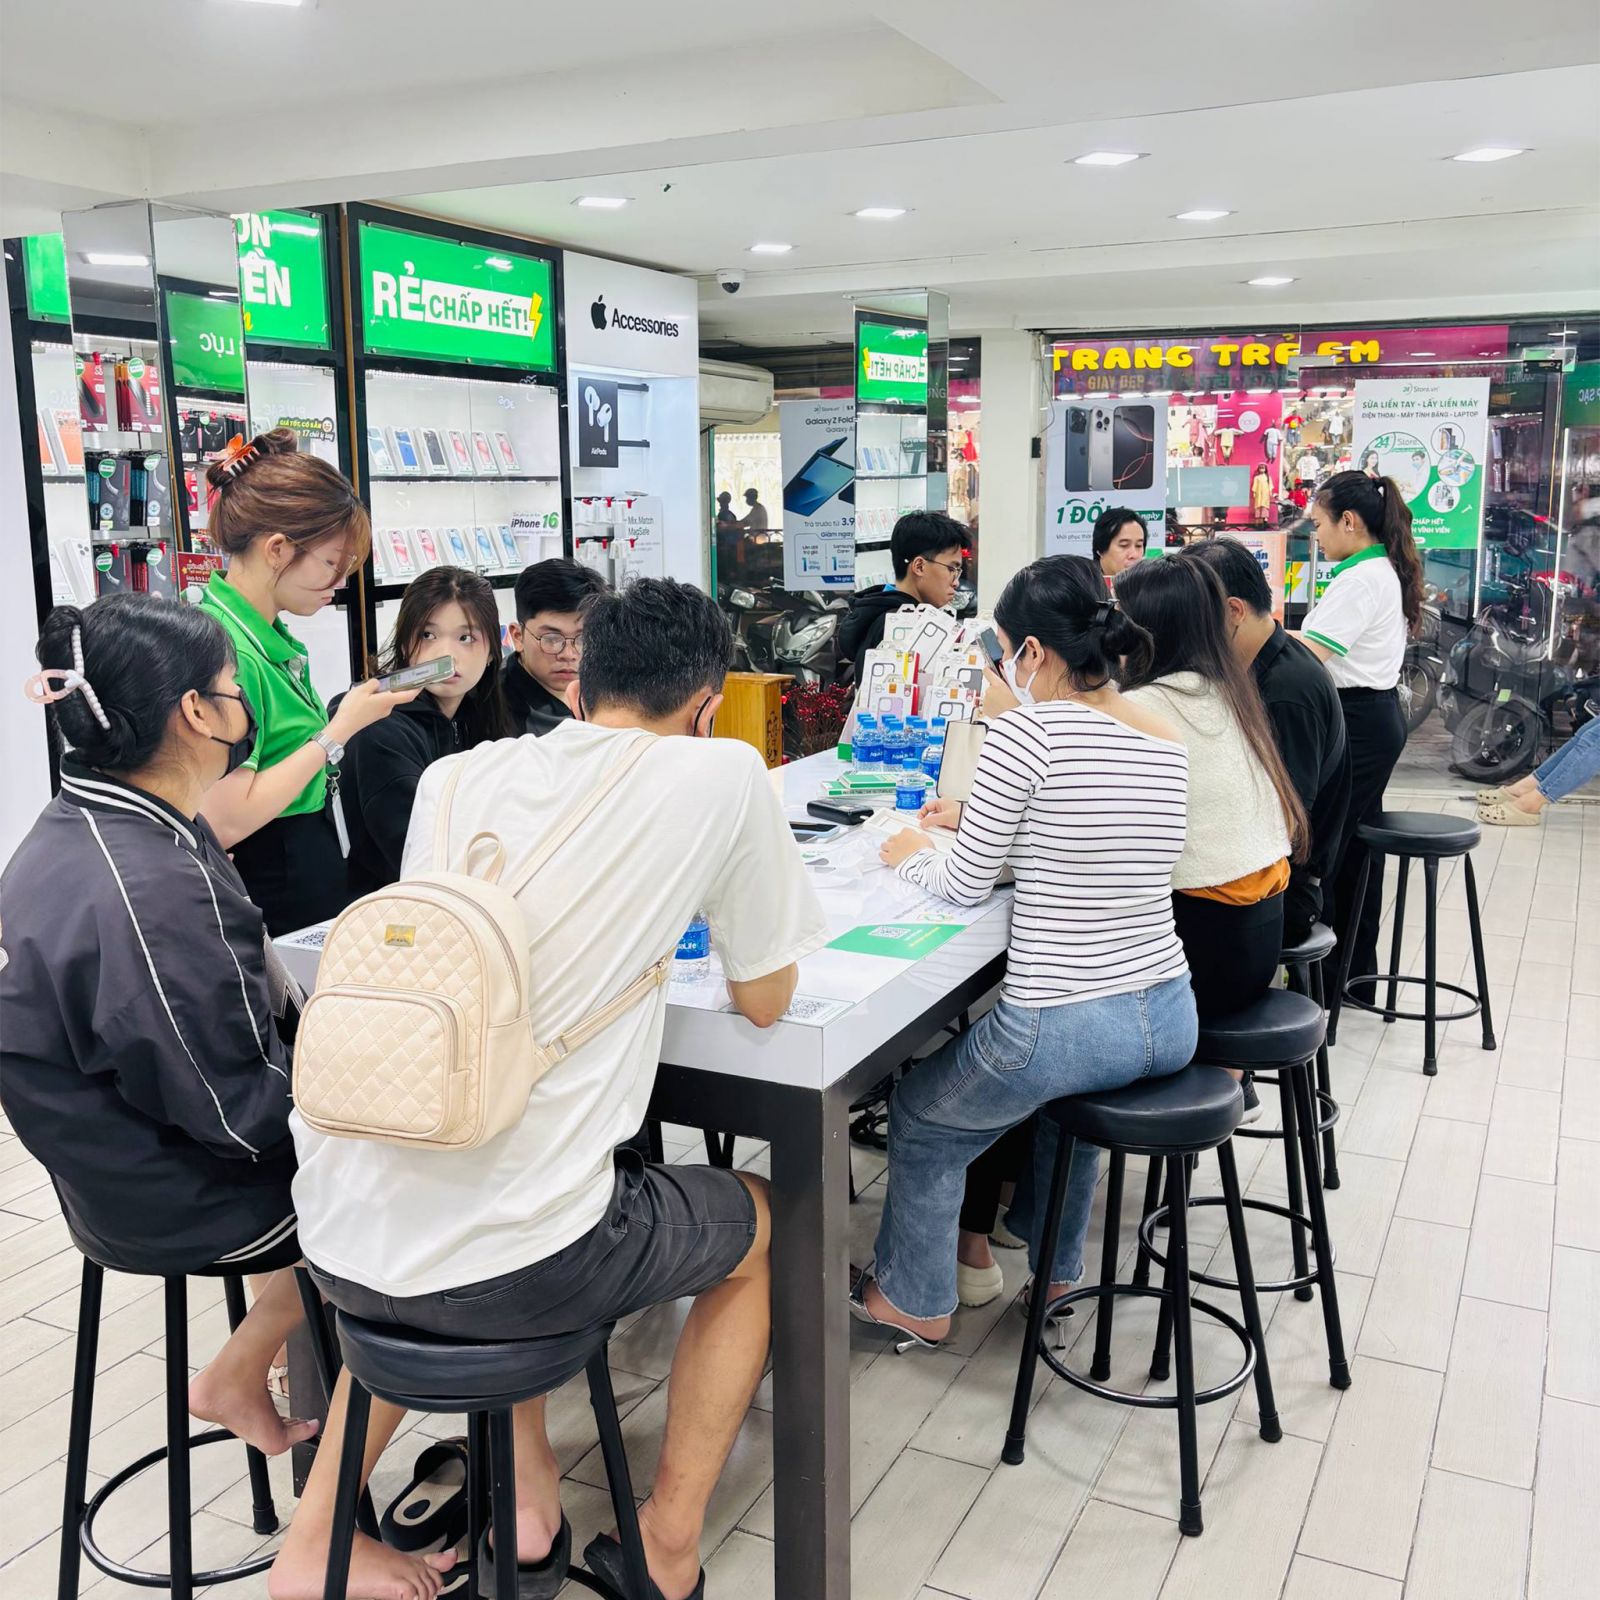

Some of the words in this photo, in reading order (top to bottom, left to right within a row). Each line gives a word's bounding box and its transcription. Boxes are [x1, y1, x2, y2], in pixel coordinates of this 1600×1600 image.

[372, 260, 426, 322] RẺ
[429, 291, 483, 325] CHẤP
[487, 298, 529, 331] HẾT!
[611, 307, 679, 337] Accessories
[1053, 346, 1193, 371] TRANG
[1401, 400, 1415, 408] TAY
[1460, 396, 1479, 407] MÁY
[805, 418, 832, 426] Galaxy
[838, 416, 854, 424] Fold
[511, 518, 540, 529] iPhone
[542, 511, 560, 529] 16
